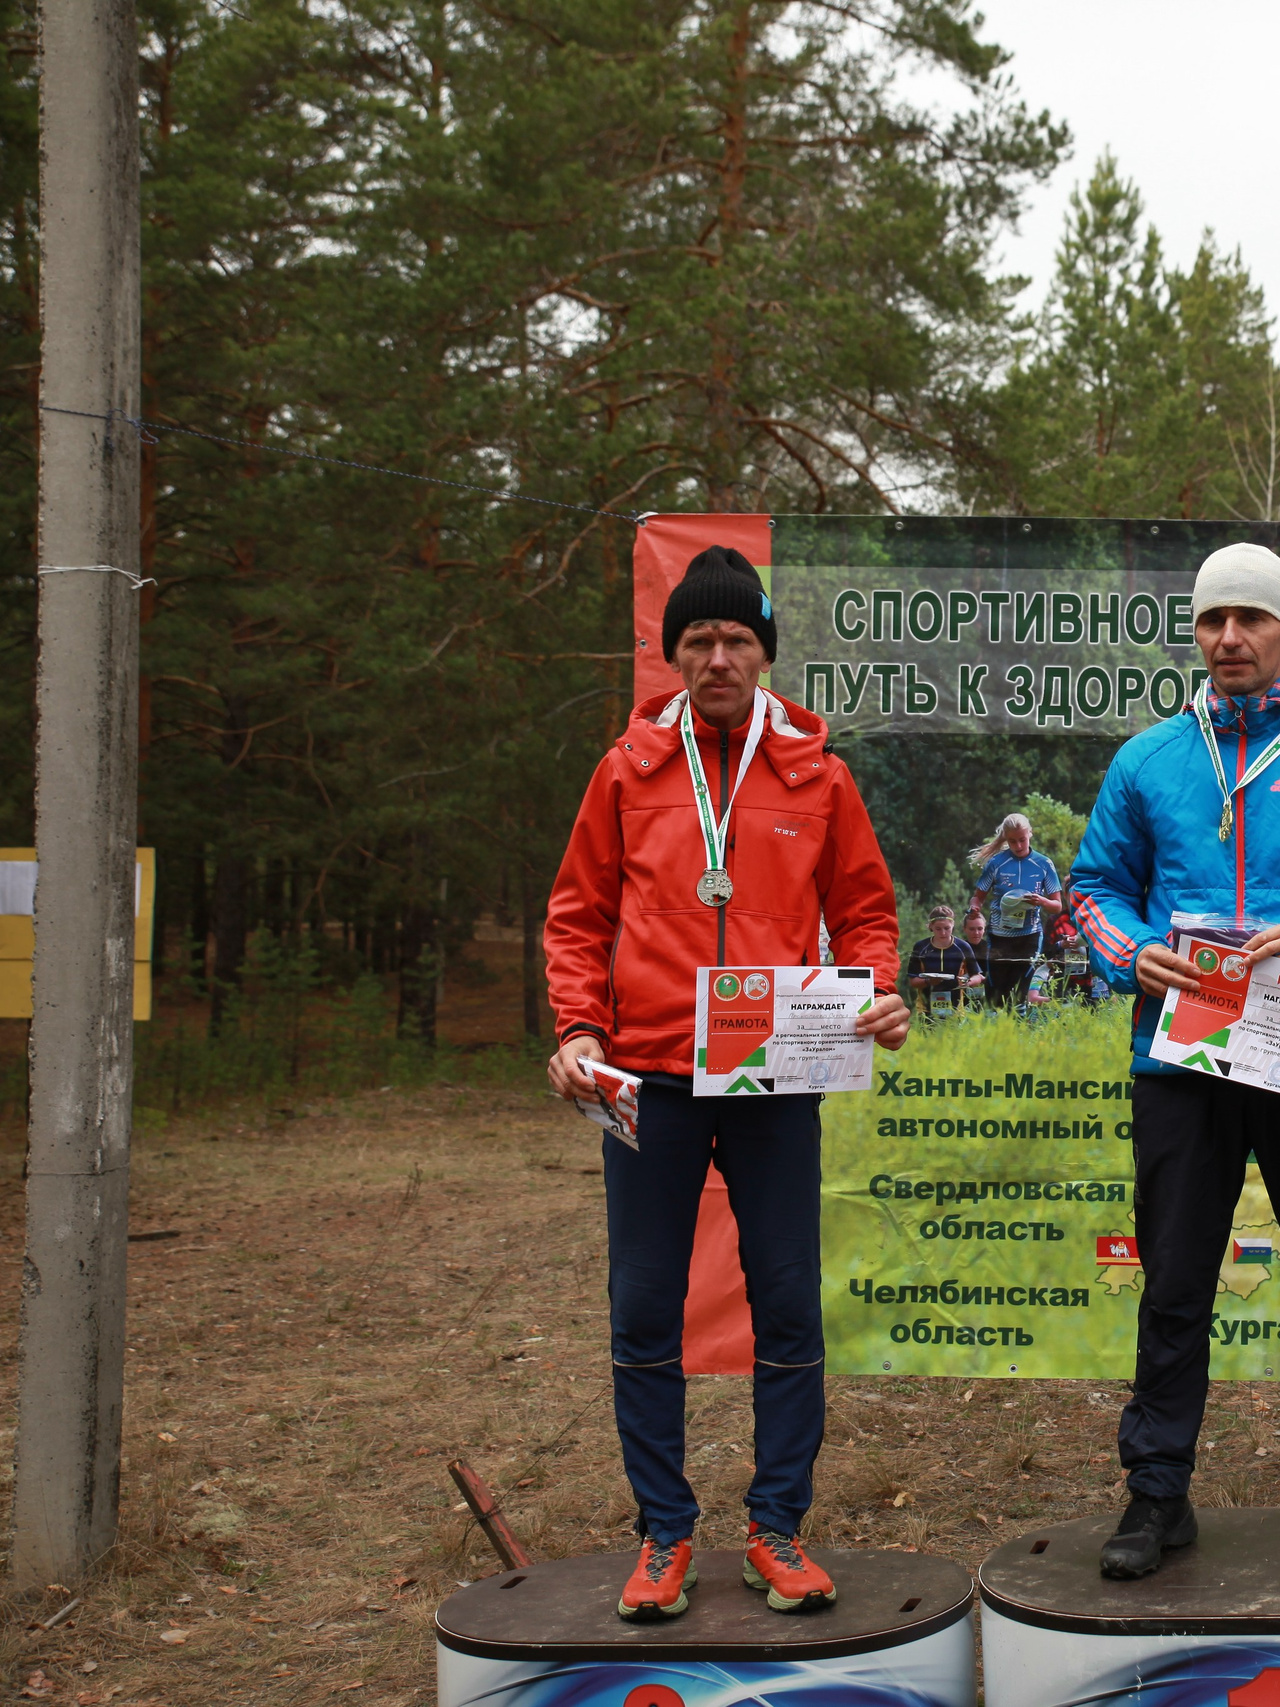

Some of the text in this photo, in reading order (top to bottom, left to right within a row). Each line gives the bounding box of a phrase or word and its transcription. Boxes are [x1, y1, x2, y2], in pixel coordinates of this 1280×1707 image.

[833, 589, 1196, 645] СПОРТИВНОЕ
[804, 662, 937, 715] ПУТЬ
[959, 664, 988, 717] К
[1186, 989, 1239, 1011] ГРАМОТА
[713, 1018, 768, 1029] ГРАМОТА
[877, 1071, 1133, 1100] Ханты-Манси
[877, 1114, 1103, 1140] автономный
[868, 1174, 1126, 1206] Свердловская
[919, 1213, 1065, 1241] область
[850, 1278, 1090, 1307] Челябинская
[889, 1317, 1034, 1346] область
